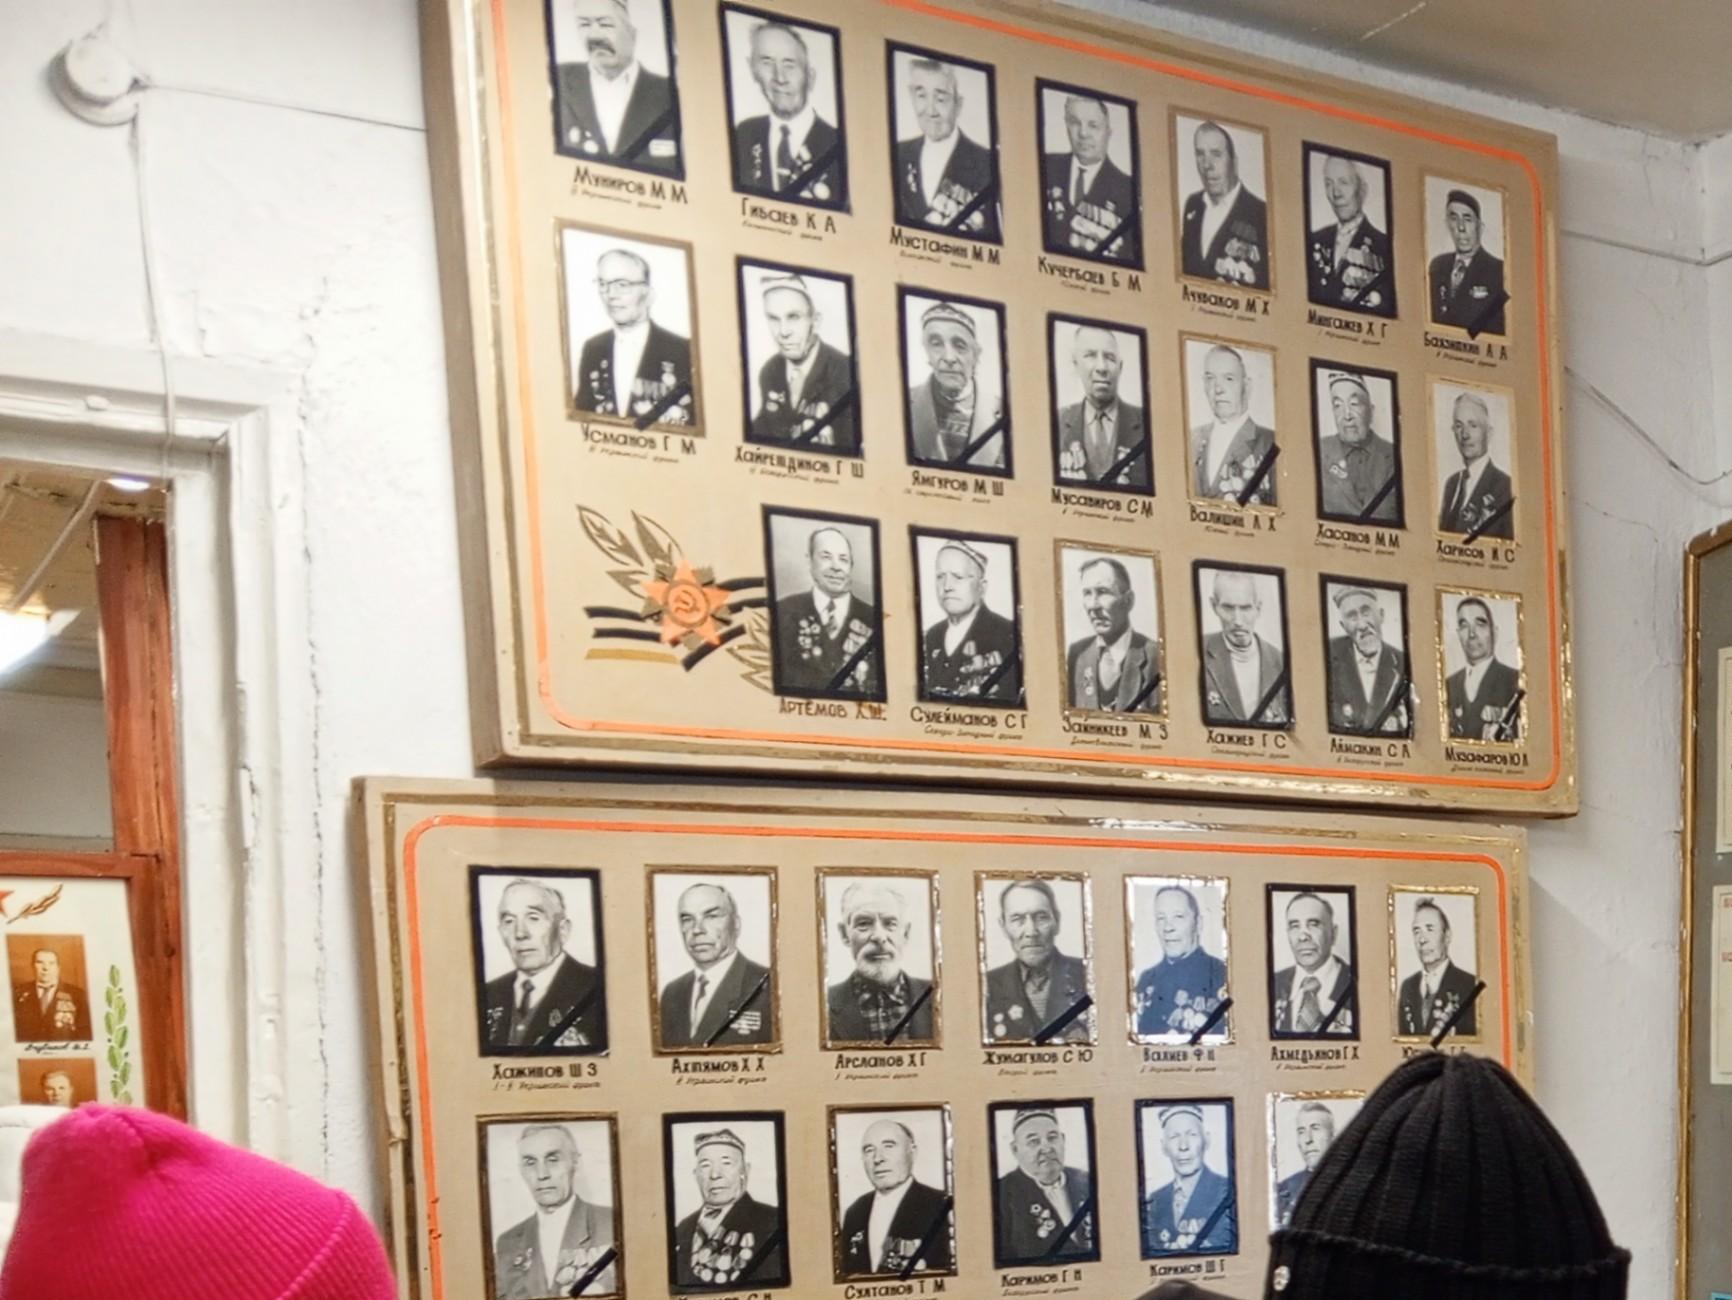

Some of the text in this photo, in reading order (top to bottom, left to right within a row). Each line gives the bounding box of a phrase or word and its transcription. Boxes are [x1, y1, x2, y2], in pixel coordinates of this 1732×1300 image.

[890, 226, 968, 258] Мустафин
[580, 423, 656, 449] Усманов
[910, 706, 997, 728] Сулейманов
[835, 1053, 904, 1069] Арсланов
